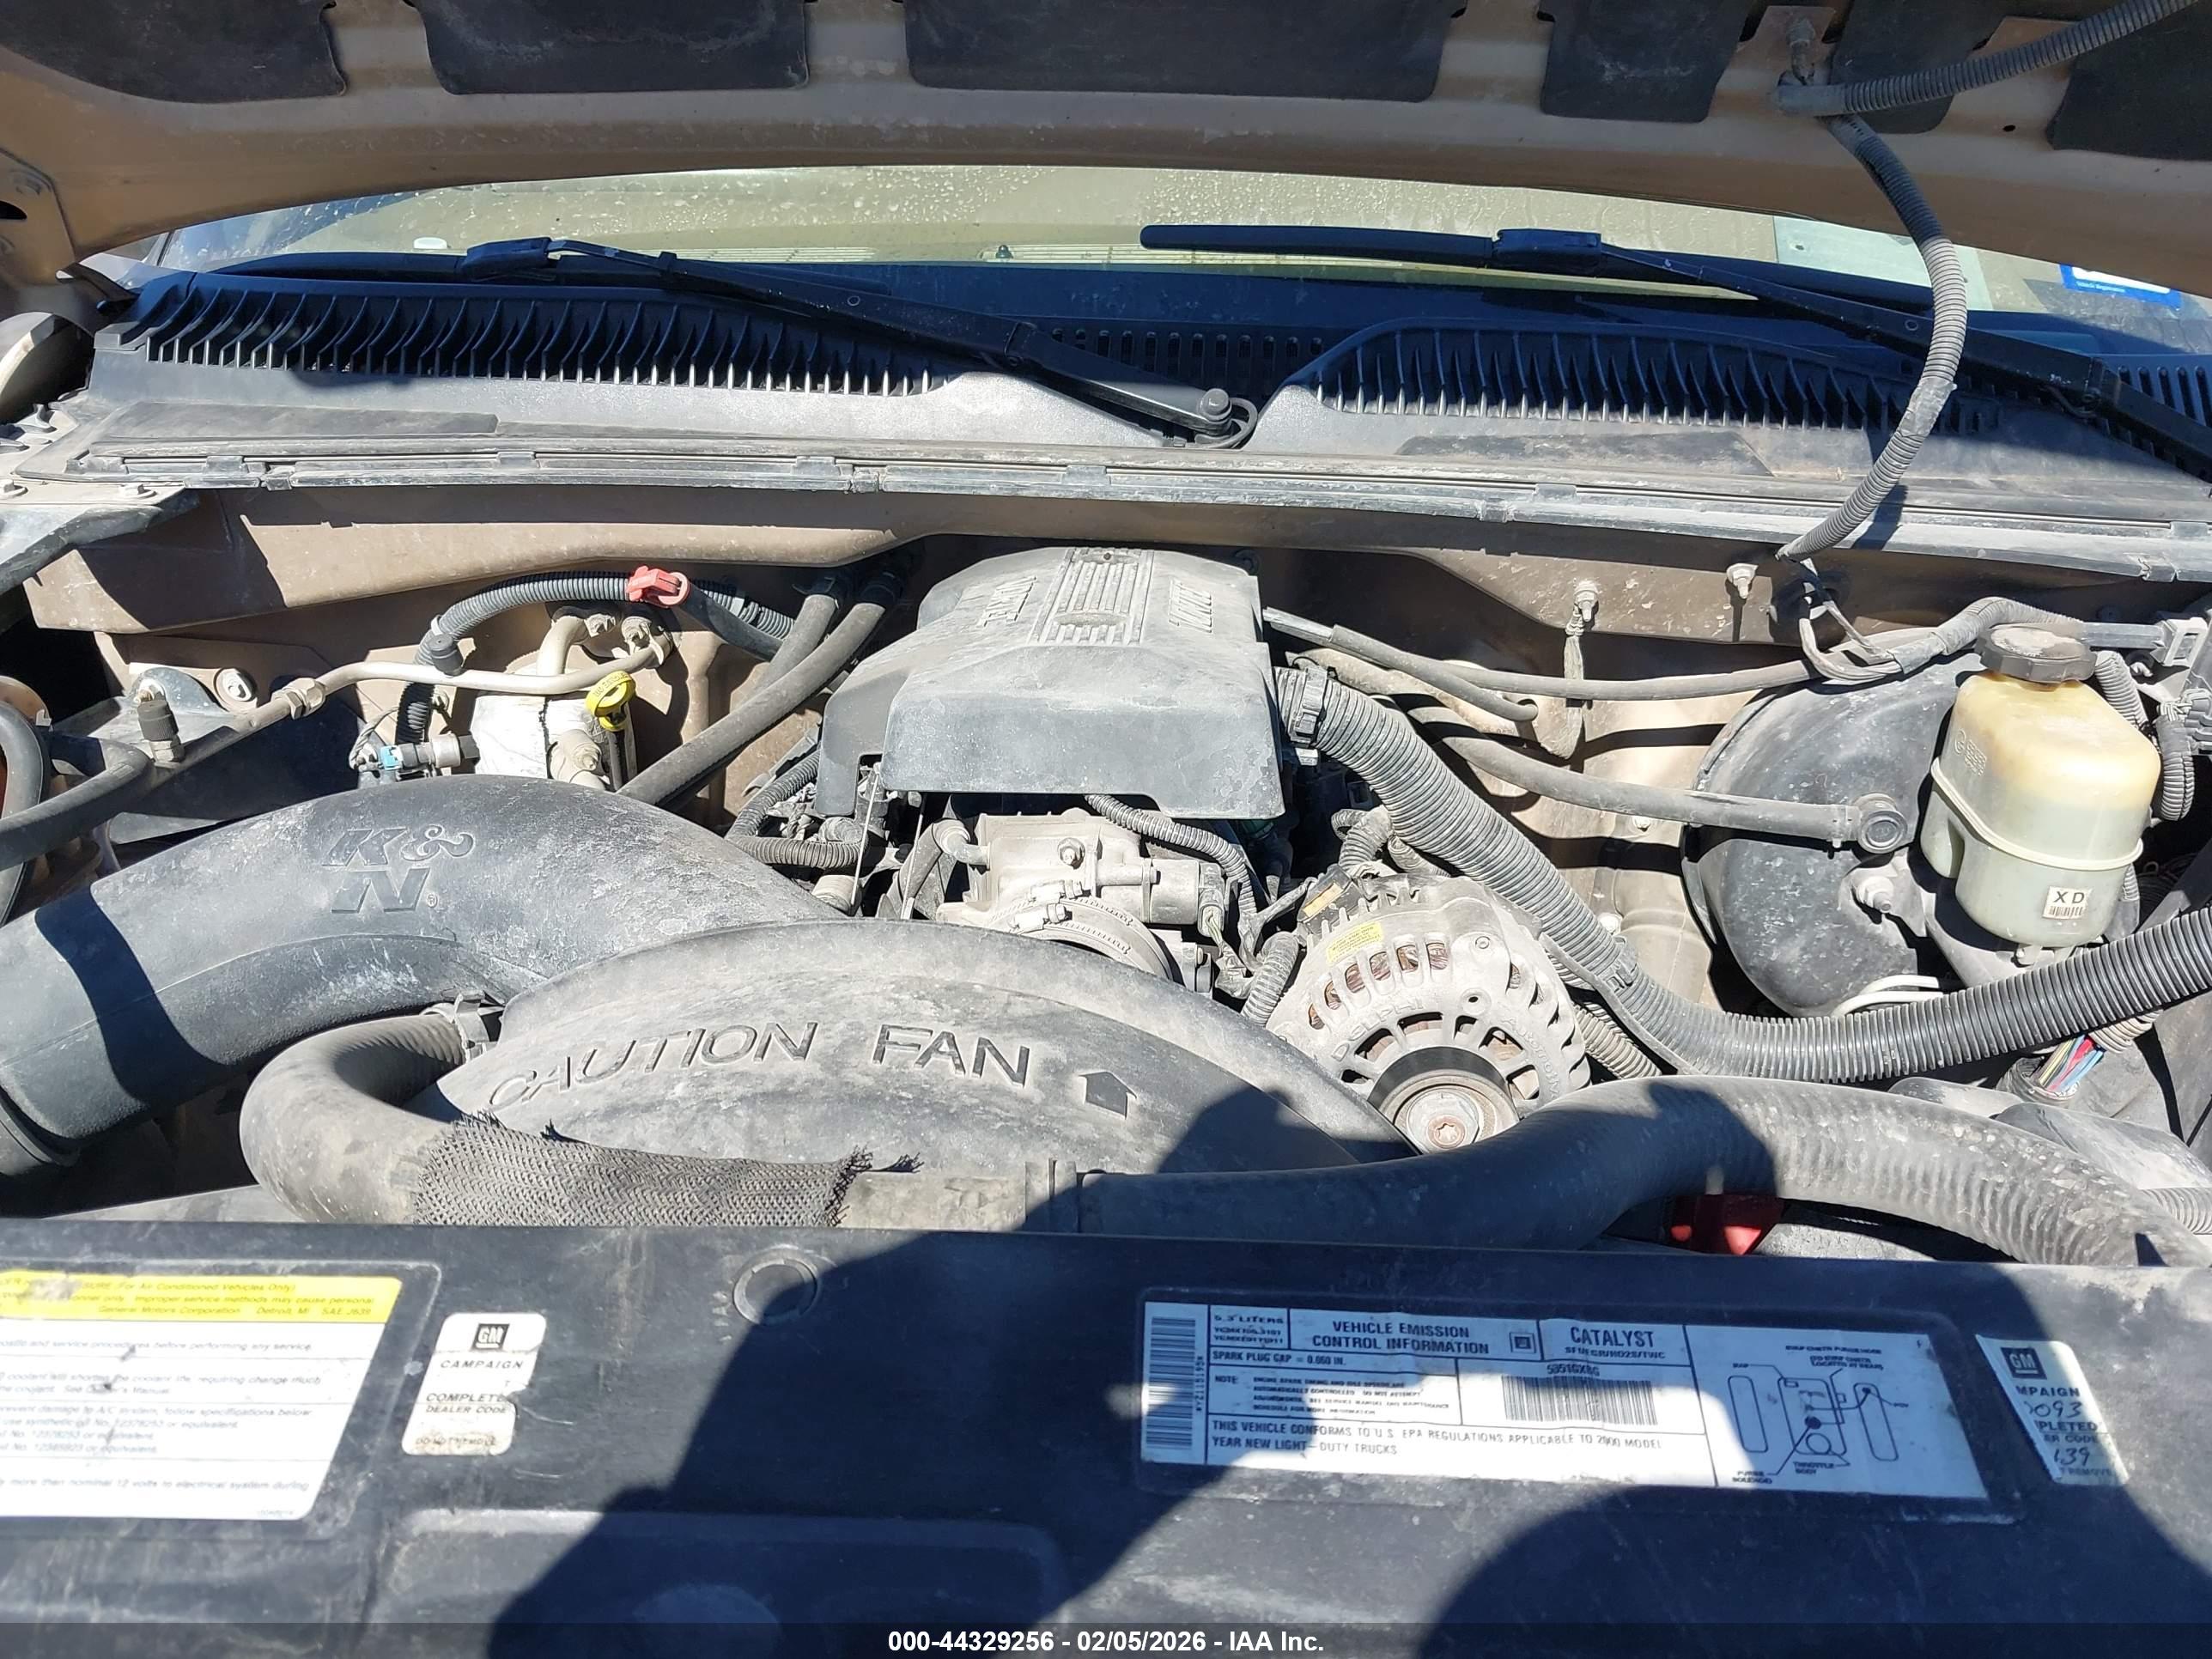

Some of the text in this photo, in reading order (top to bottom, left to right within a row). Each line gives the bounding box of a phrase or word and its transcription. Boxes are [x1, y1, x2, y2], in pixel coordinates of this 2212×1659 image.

[489, 1021, 1032, 1109] CAUTION FAN
[477, 1326, 504, 1344] GM
[1333, 1321, 1469, 1338] VEHICLE EMISSION
[1571, 1326, 1655, 1348] CATALYST
[1312, 1334, 1489, 1354] CONTROL INFORMATION
[440, 1359, 524, 1369] CAMPAIGN
[1212, 1351, 1243, 1361] SPARK
[1246, 1352, 1271, 1362] PLUG
[1273, 1352, 1291, 1363] GAP
[2008, 1352, 2037, 1370] GM
[425, 1405, 507, 1414] DEALER CODE
[1212, 1419, 1237, 1432] THIS
[1241, 1421, 1286, 1435] VEHICLE
[1291, 1423, 1352, 1437] CONFORMS
[1358, 1427, 1372, 1437] TO
[1401, 1429, 1424, 1440] EPA
[1428, 1430, 1504, 1443] REGULATIONS
[1508, 1434, 1575, 1445] APPLICABLE
[1579, 1433, 1594, 1444] TO
[1624, 1438, 1663, 1449] MODEL
[1212, 1436, 1243, 1449] YEAR
[1245, 1437, 1272, 1449] NEW
[1354, 1443, 1398, 1455] TRUCKS
